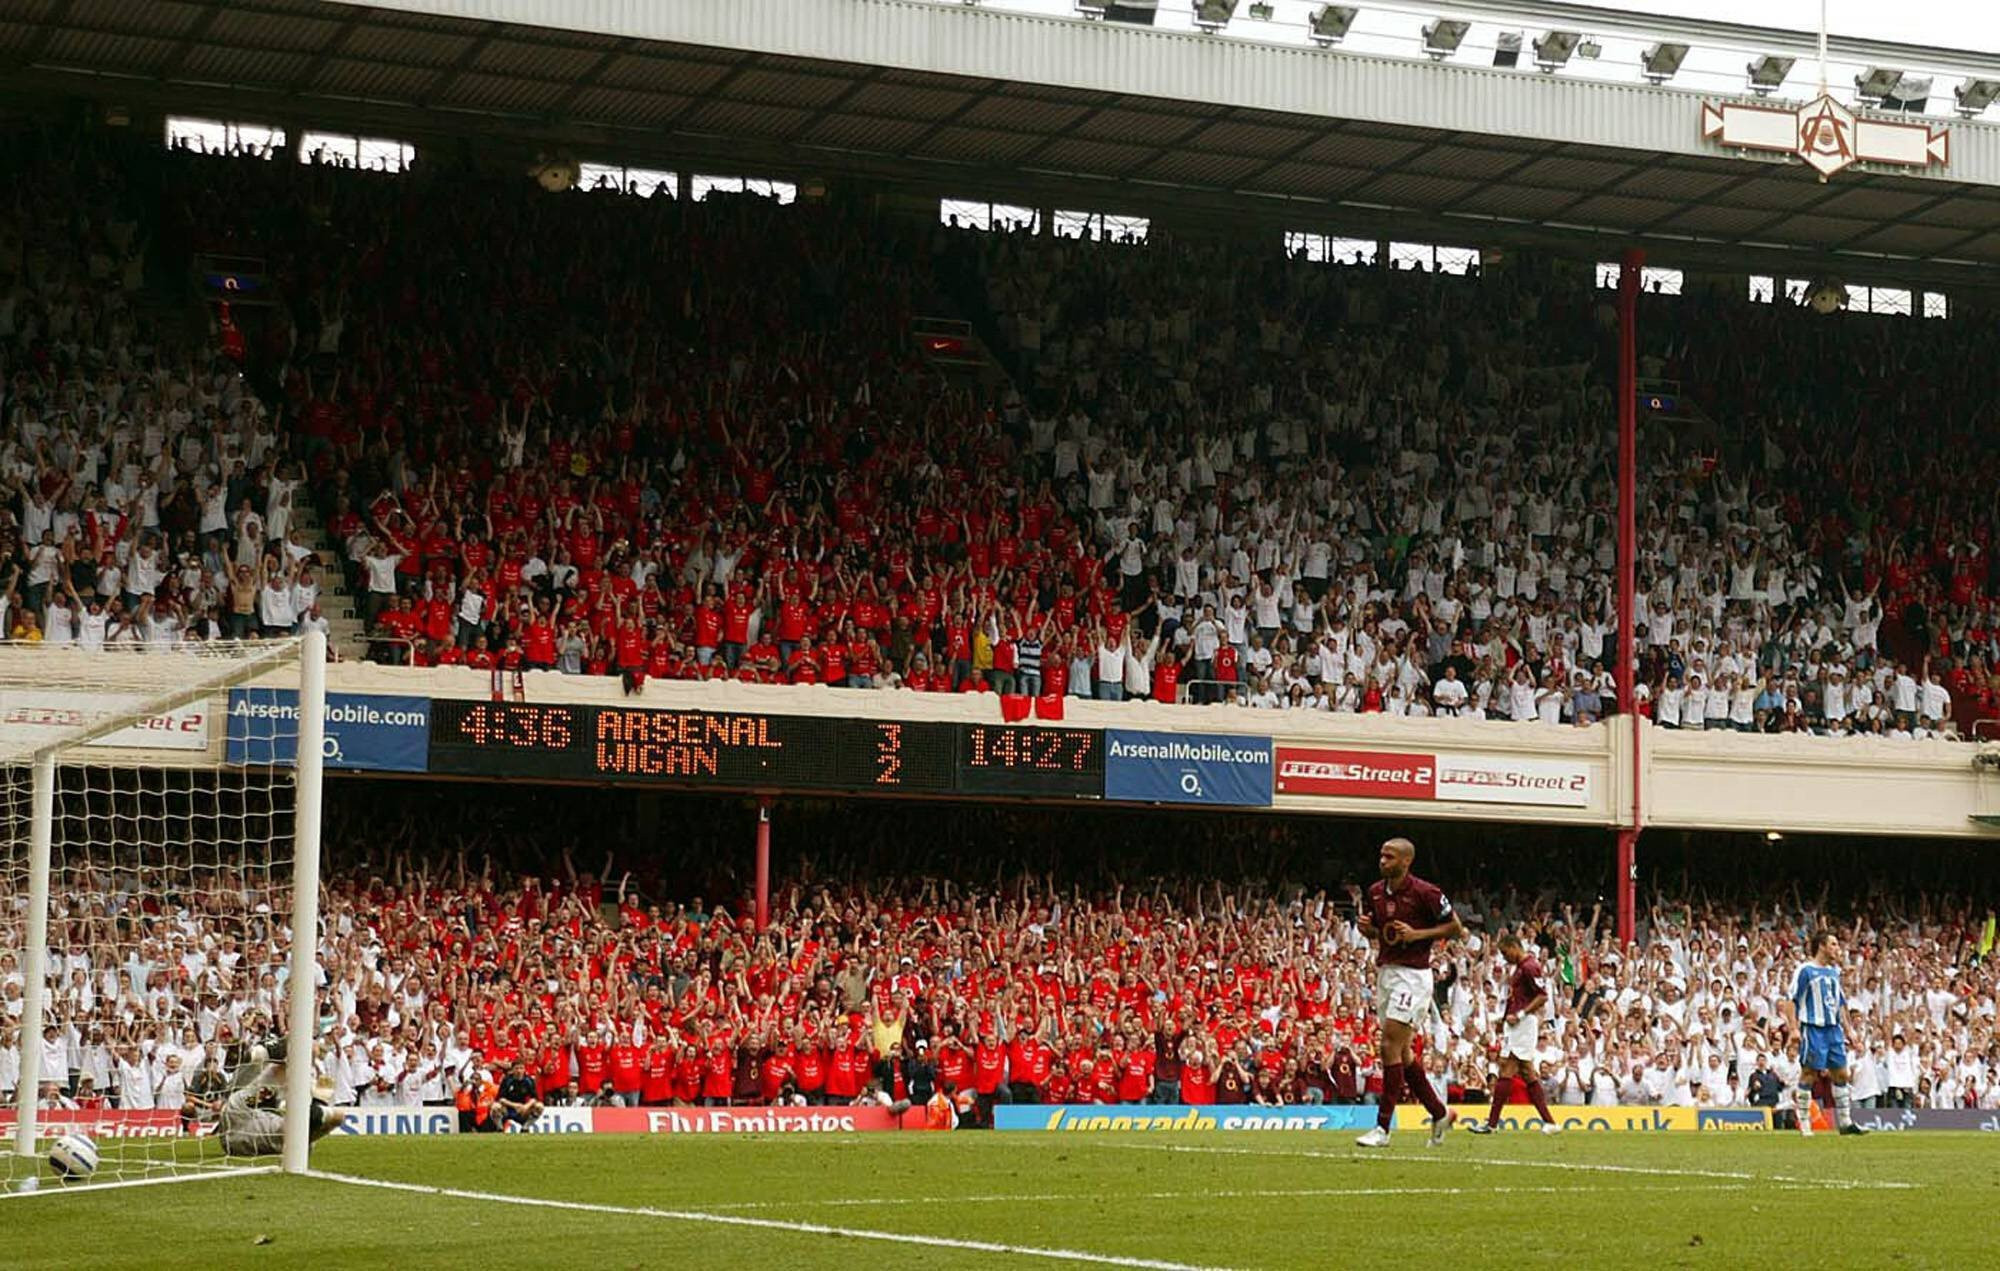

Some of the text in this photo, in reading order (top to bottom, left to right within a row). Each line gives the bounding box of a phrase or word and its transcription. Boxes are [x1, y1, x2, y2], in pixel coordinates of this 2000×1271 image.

[181, 715, 202, 732] 2
[460, 705, 572, 748] 4:36
[596, 710, 900, 752] ARSENAL 3
[596, 742, 900, 783] WIGAN 2
[971, 728, 1092, 769] 14:27
[1110, 739, 1269, 765] ArsenalMobile.com
[1347, 764, 1411, 783] Street
[1414, 766, 1432, 785] 2
[1505, 772, 1566, 790] Street
[1569, 775, 1586, 791] 2
